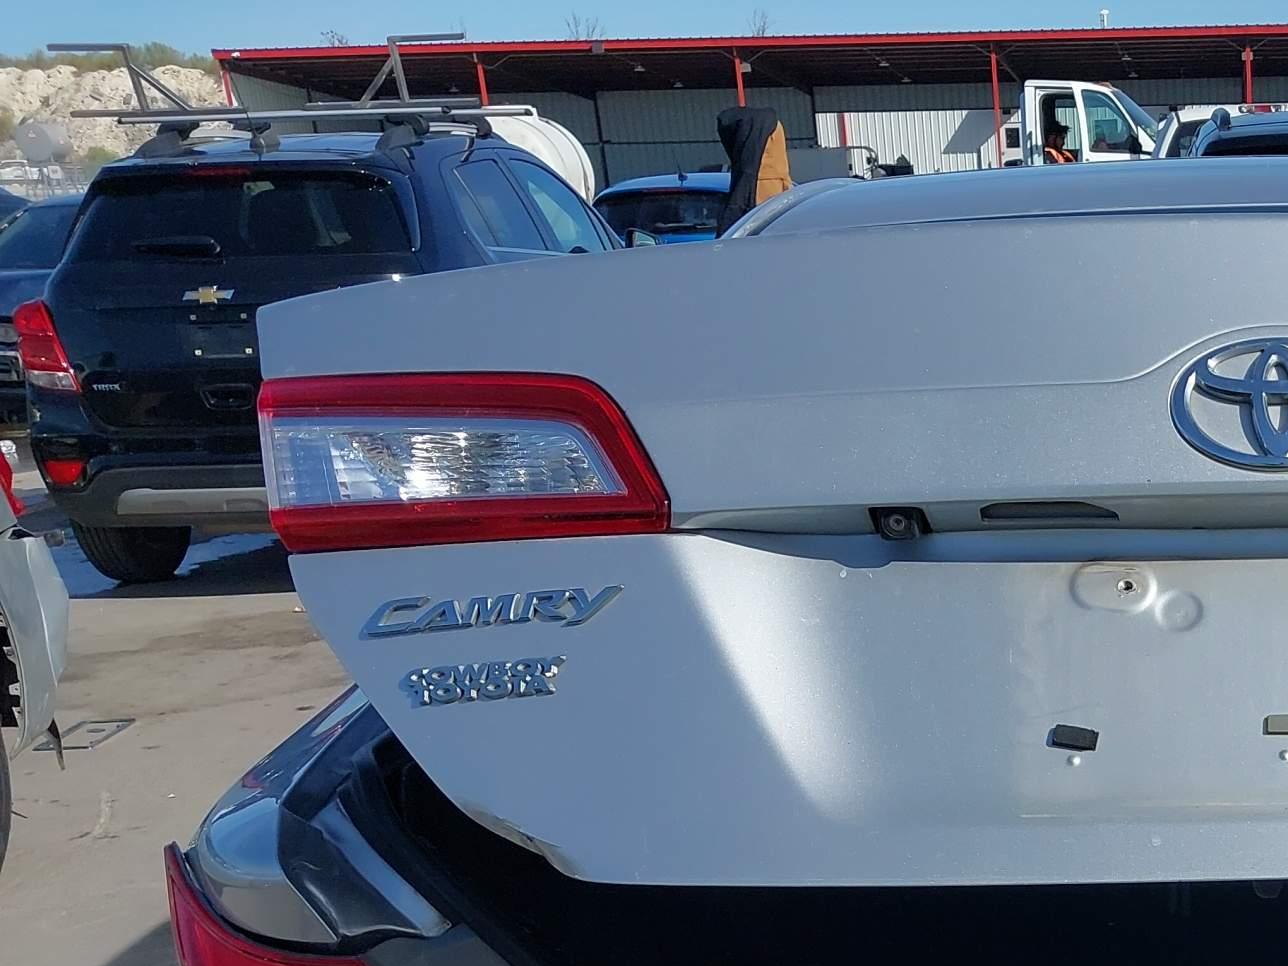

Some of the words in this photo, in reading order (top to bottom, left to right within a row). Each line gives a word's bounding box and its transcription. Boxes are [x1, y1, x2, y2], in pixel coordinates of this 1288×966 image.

[359, 584, 625, 640] CAMRY
[400, 655, 567, 689] COWBOY
[410, 671, 557, 707] TOYOTA
